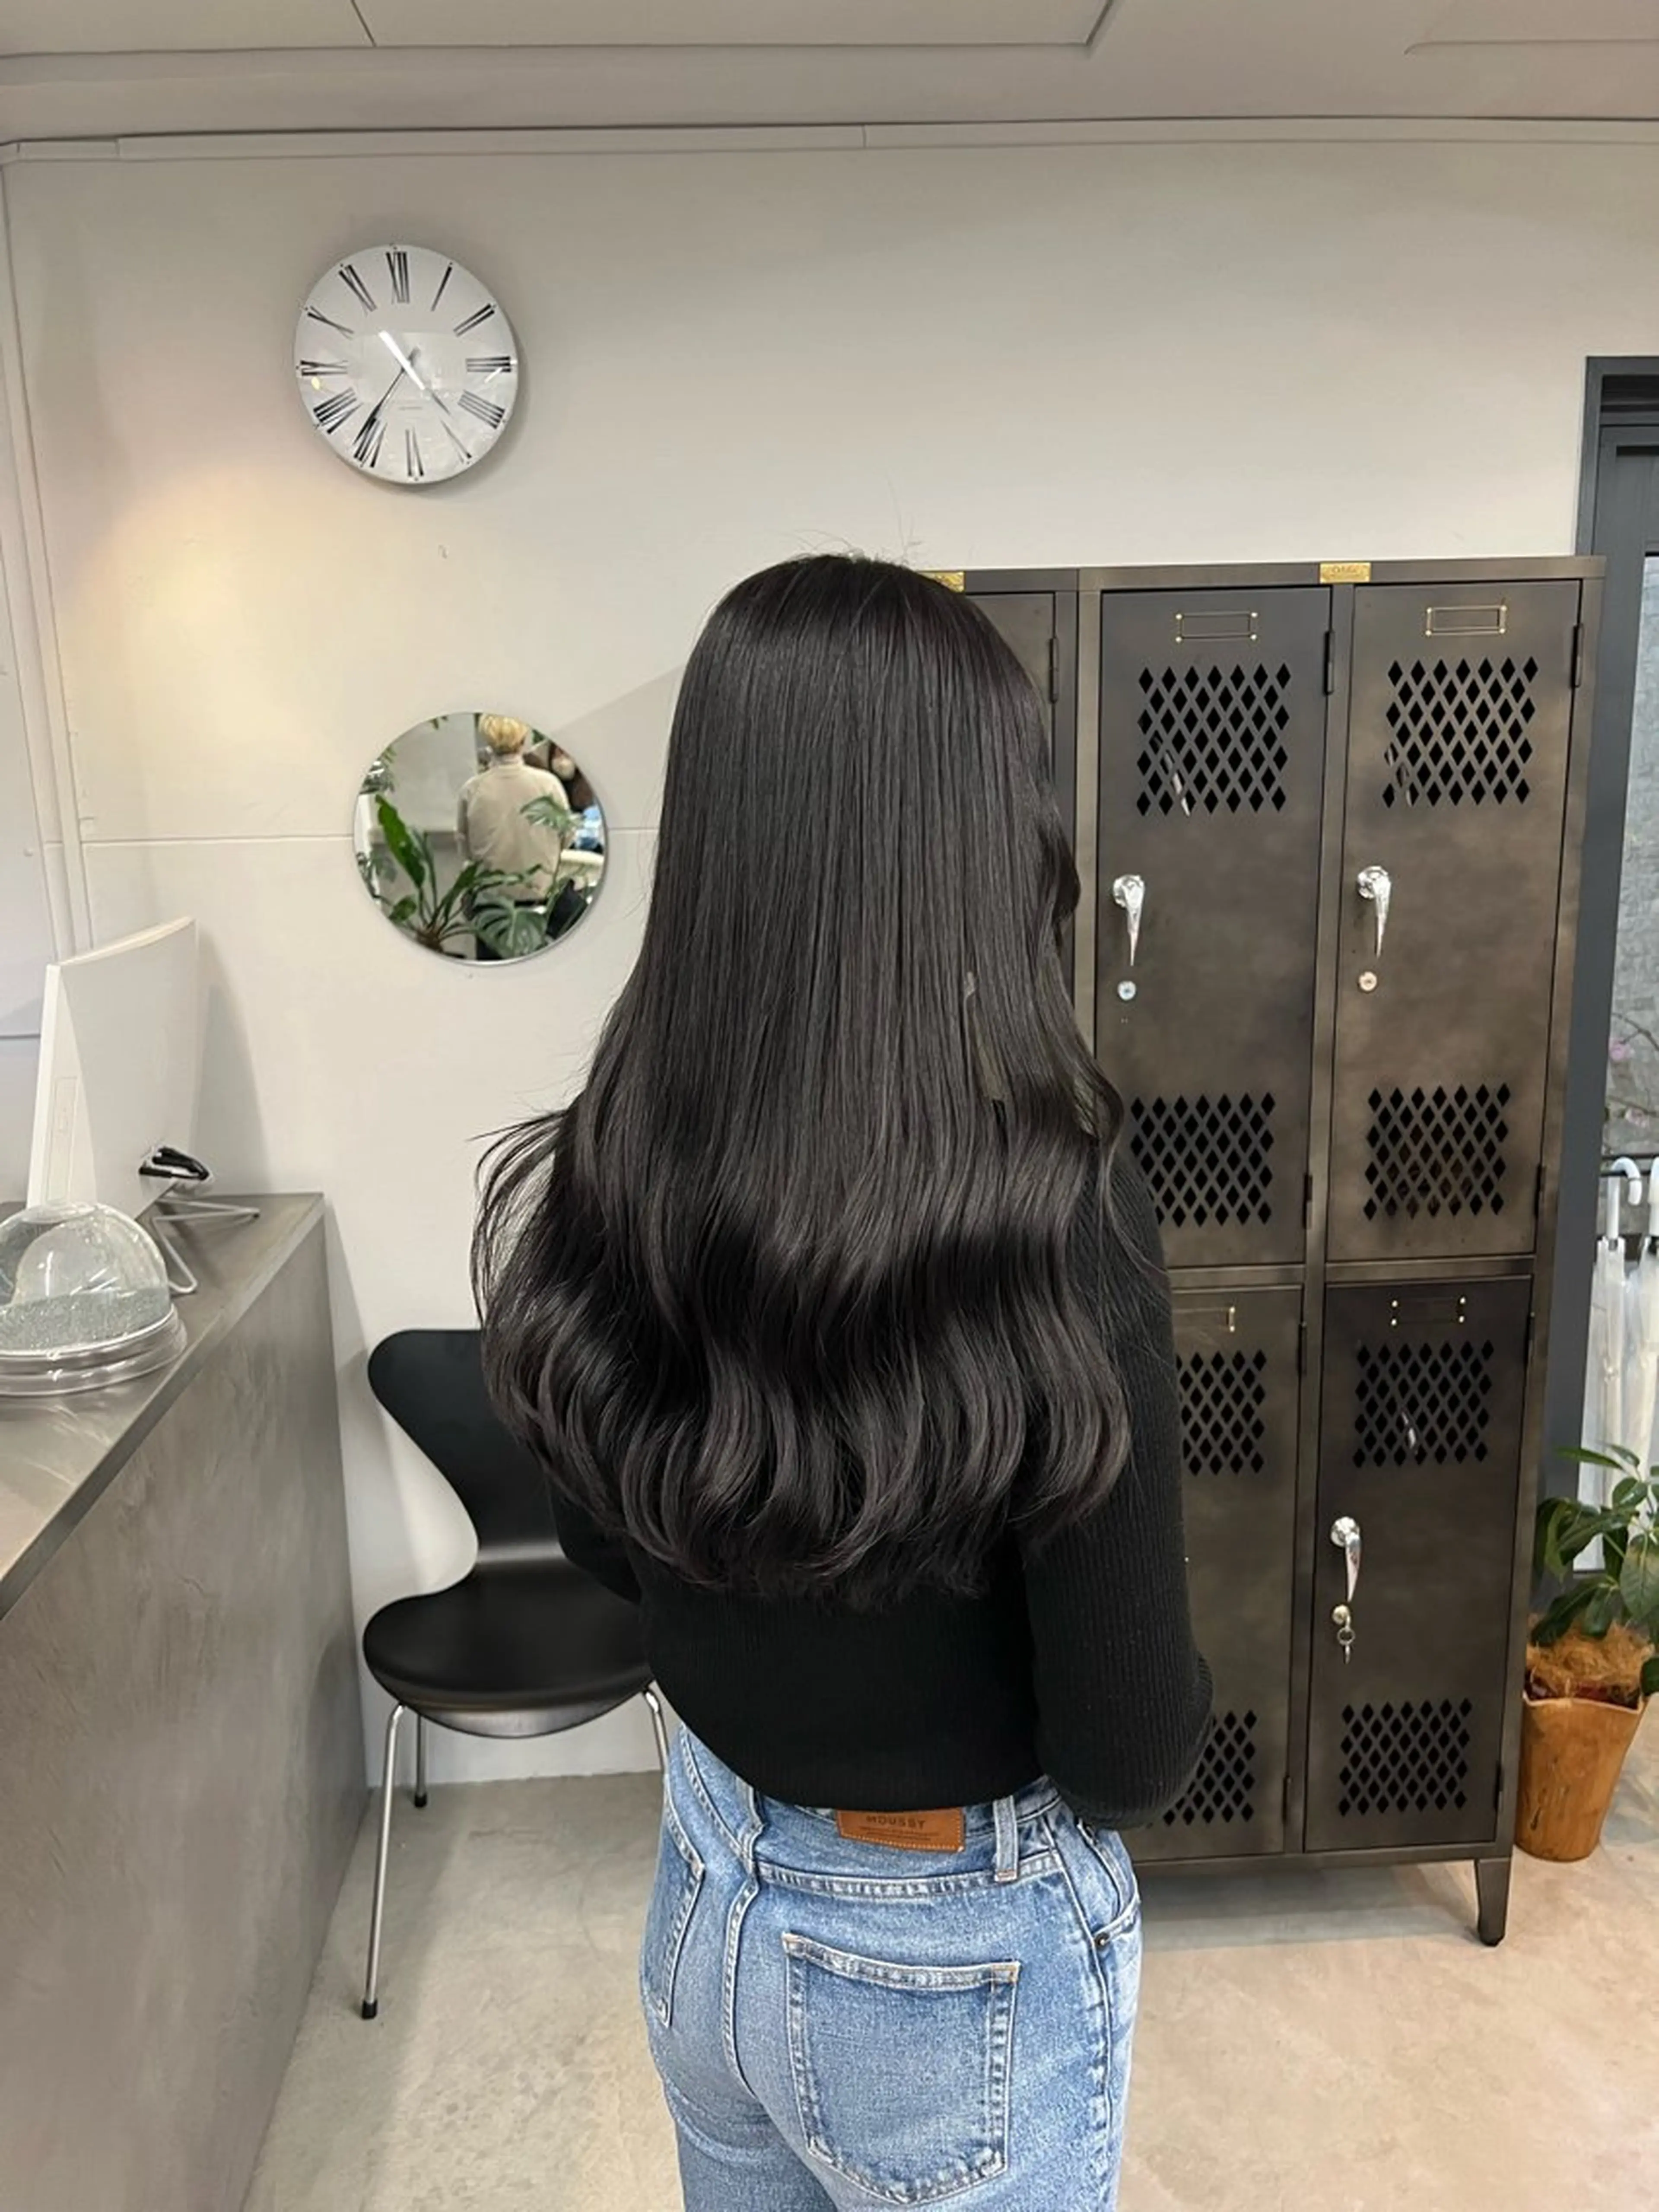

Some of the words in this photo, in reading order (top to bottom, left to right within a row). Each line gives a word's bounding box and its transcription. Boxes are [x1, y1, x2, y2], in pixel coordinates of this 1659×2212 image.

[386, 251, 410, 305] XII
[453, 302, 495, 337] II
[465, 355, 512, 372] III
[405, 428, 425, 477] VI
[865, 1815, 926, 1830] MOUSSY
